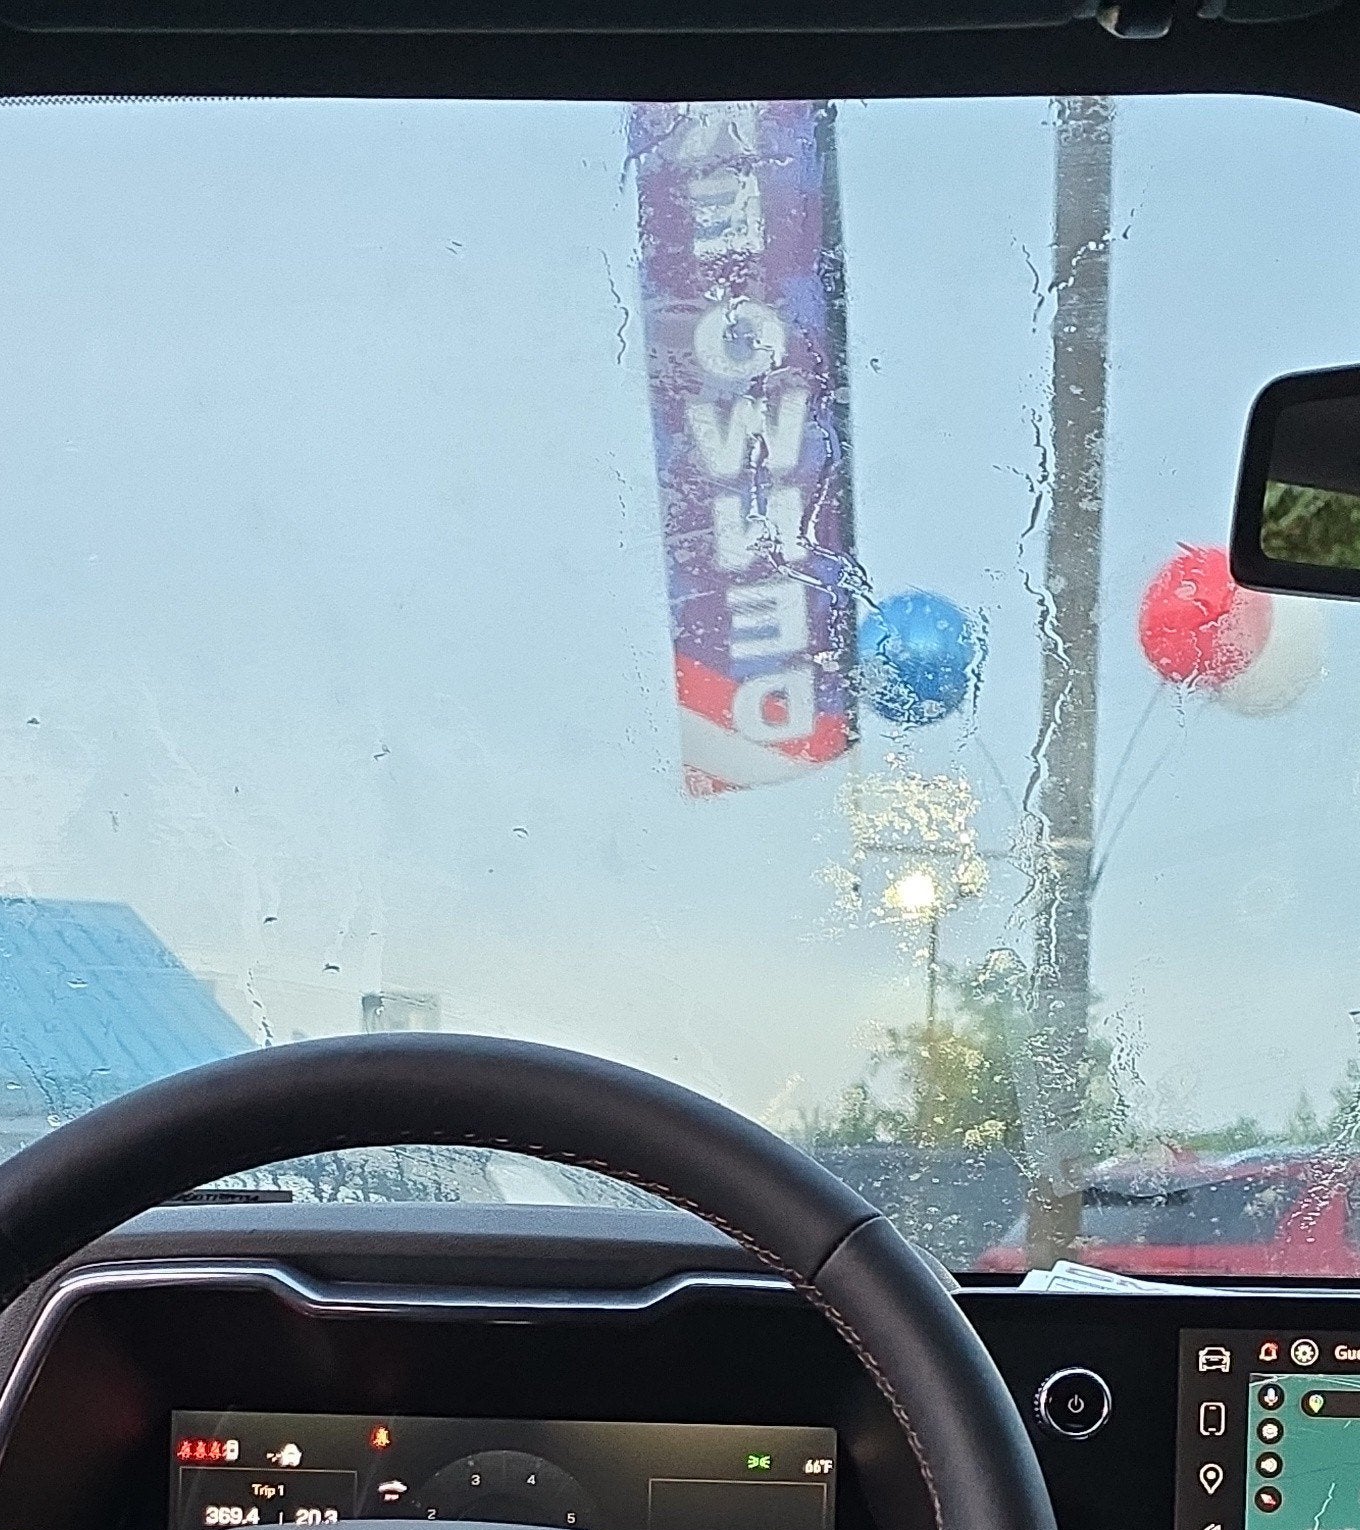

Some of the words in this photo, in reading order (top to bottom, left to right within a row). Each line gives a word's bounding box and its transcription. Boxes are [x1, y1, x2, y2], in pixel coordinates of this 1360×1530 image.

[470, 1474, 482, 1487] 3
[526, 1474, 537, 1486] 4
[251, 1483, 277, 1499] Trip
[277, 1484, 285, 1497] 1
[204, 1506, 261, 1526] 369.4
[295, 1508, 339, 1526] 20.3
[426, 1508, 437, 1520] 2
[566, 1512, 577, 1524] 5
